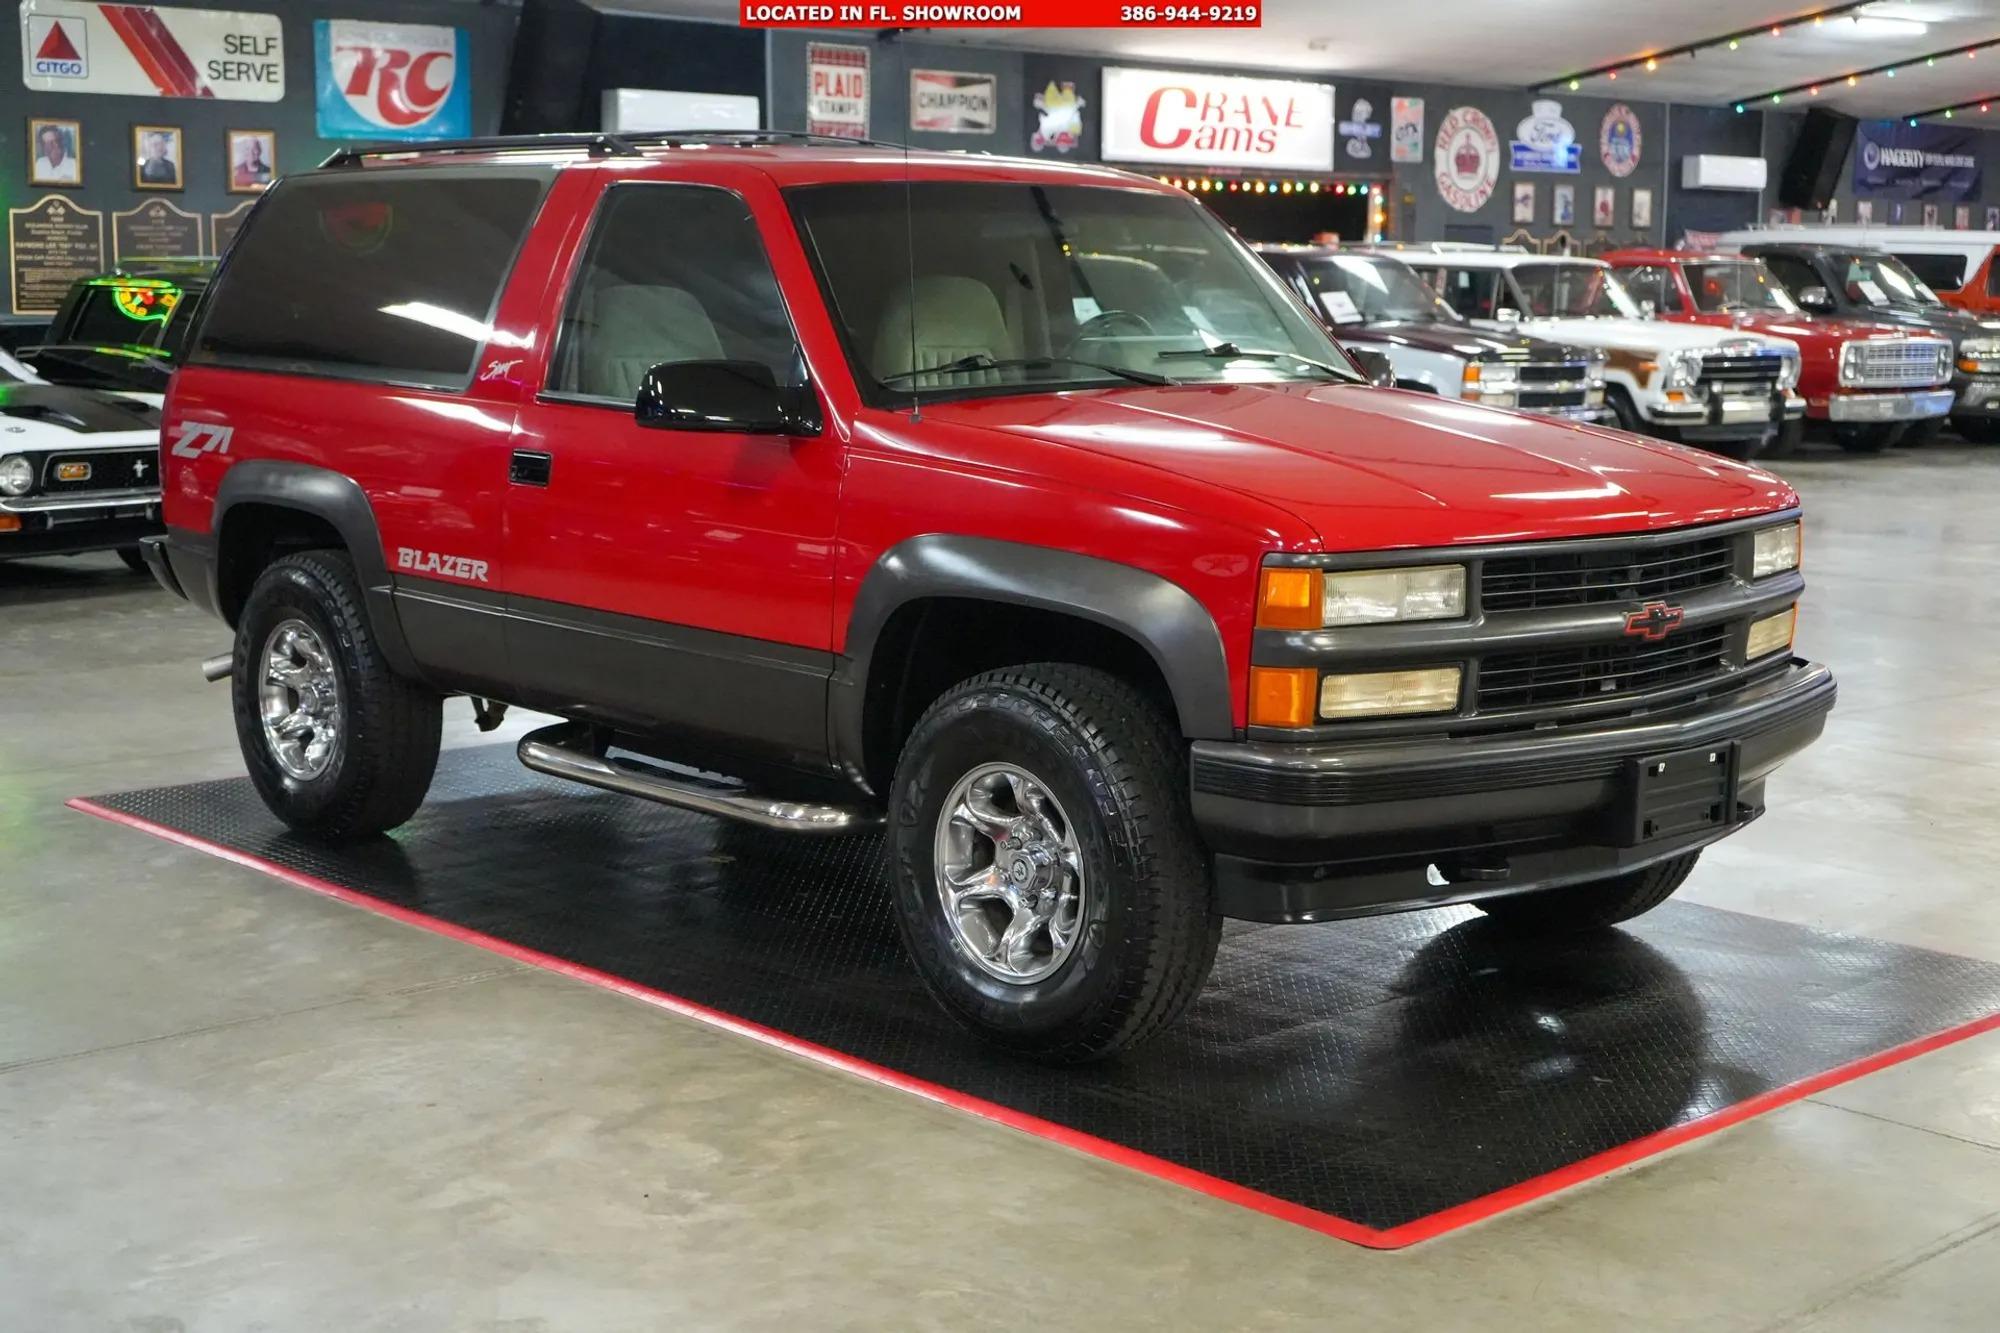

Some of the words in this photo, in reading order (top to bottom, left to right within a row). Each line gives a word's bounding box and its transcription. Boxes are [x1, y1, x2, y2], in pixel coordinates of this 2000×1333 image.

[223, 34, 278, 56] SELF
[36, 60, 82, 76] CITGO
[207, 59, 280, 83] SERVE
[335, 45, 453, 126] RC
[814, 72, 863, 99] PLAID
[817, 99, 861, 116] STAMPS
[919, 92, 989, 112] CHAMPION
[171, 420, 235, 459] Z71
[397, 546, 489, 582] BLAZER
